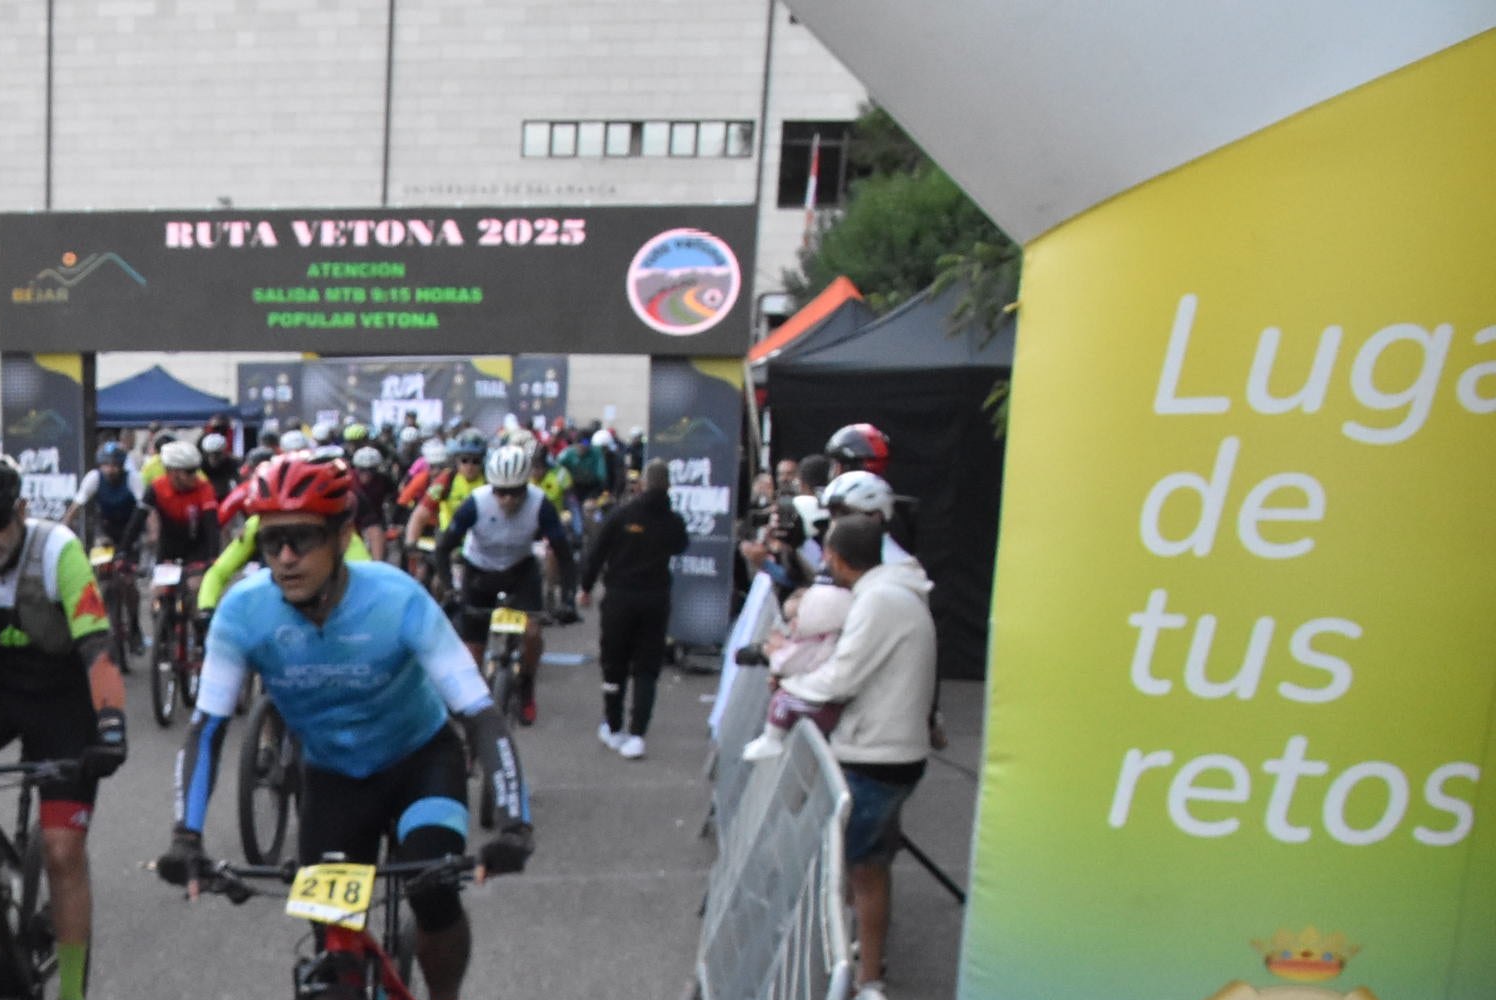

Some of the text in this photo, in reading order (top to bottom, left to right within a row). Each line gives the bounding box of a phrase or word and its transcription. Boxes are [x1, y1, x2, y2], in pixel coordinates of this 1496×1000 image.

[165, 218, 587, 248] RUTA VETONA 2025
[307, 261, 406, 279] ATENCION
[252, 287, 321, 303] SALIDA
[324, 287, 367, 303] MTB
[414, 286, 483, 304] HORAS
[266, 311, 440, 329] POPULAR VETONA
[1139, 436, 1327, 559] de
[1128, 588, 1363, 704] tus
[1108, 735, 1481, 846] retos
[300, 877, 362, 904] 218
